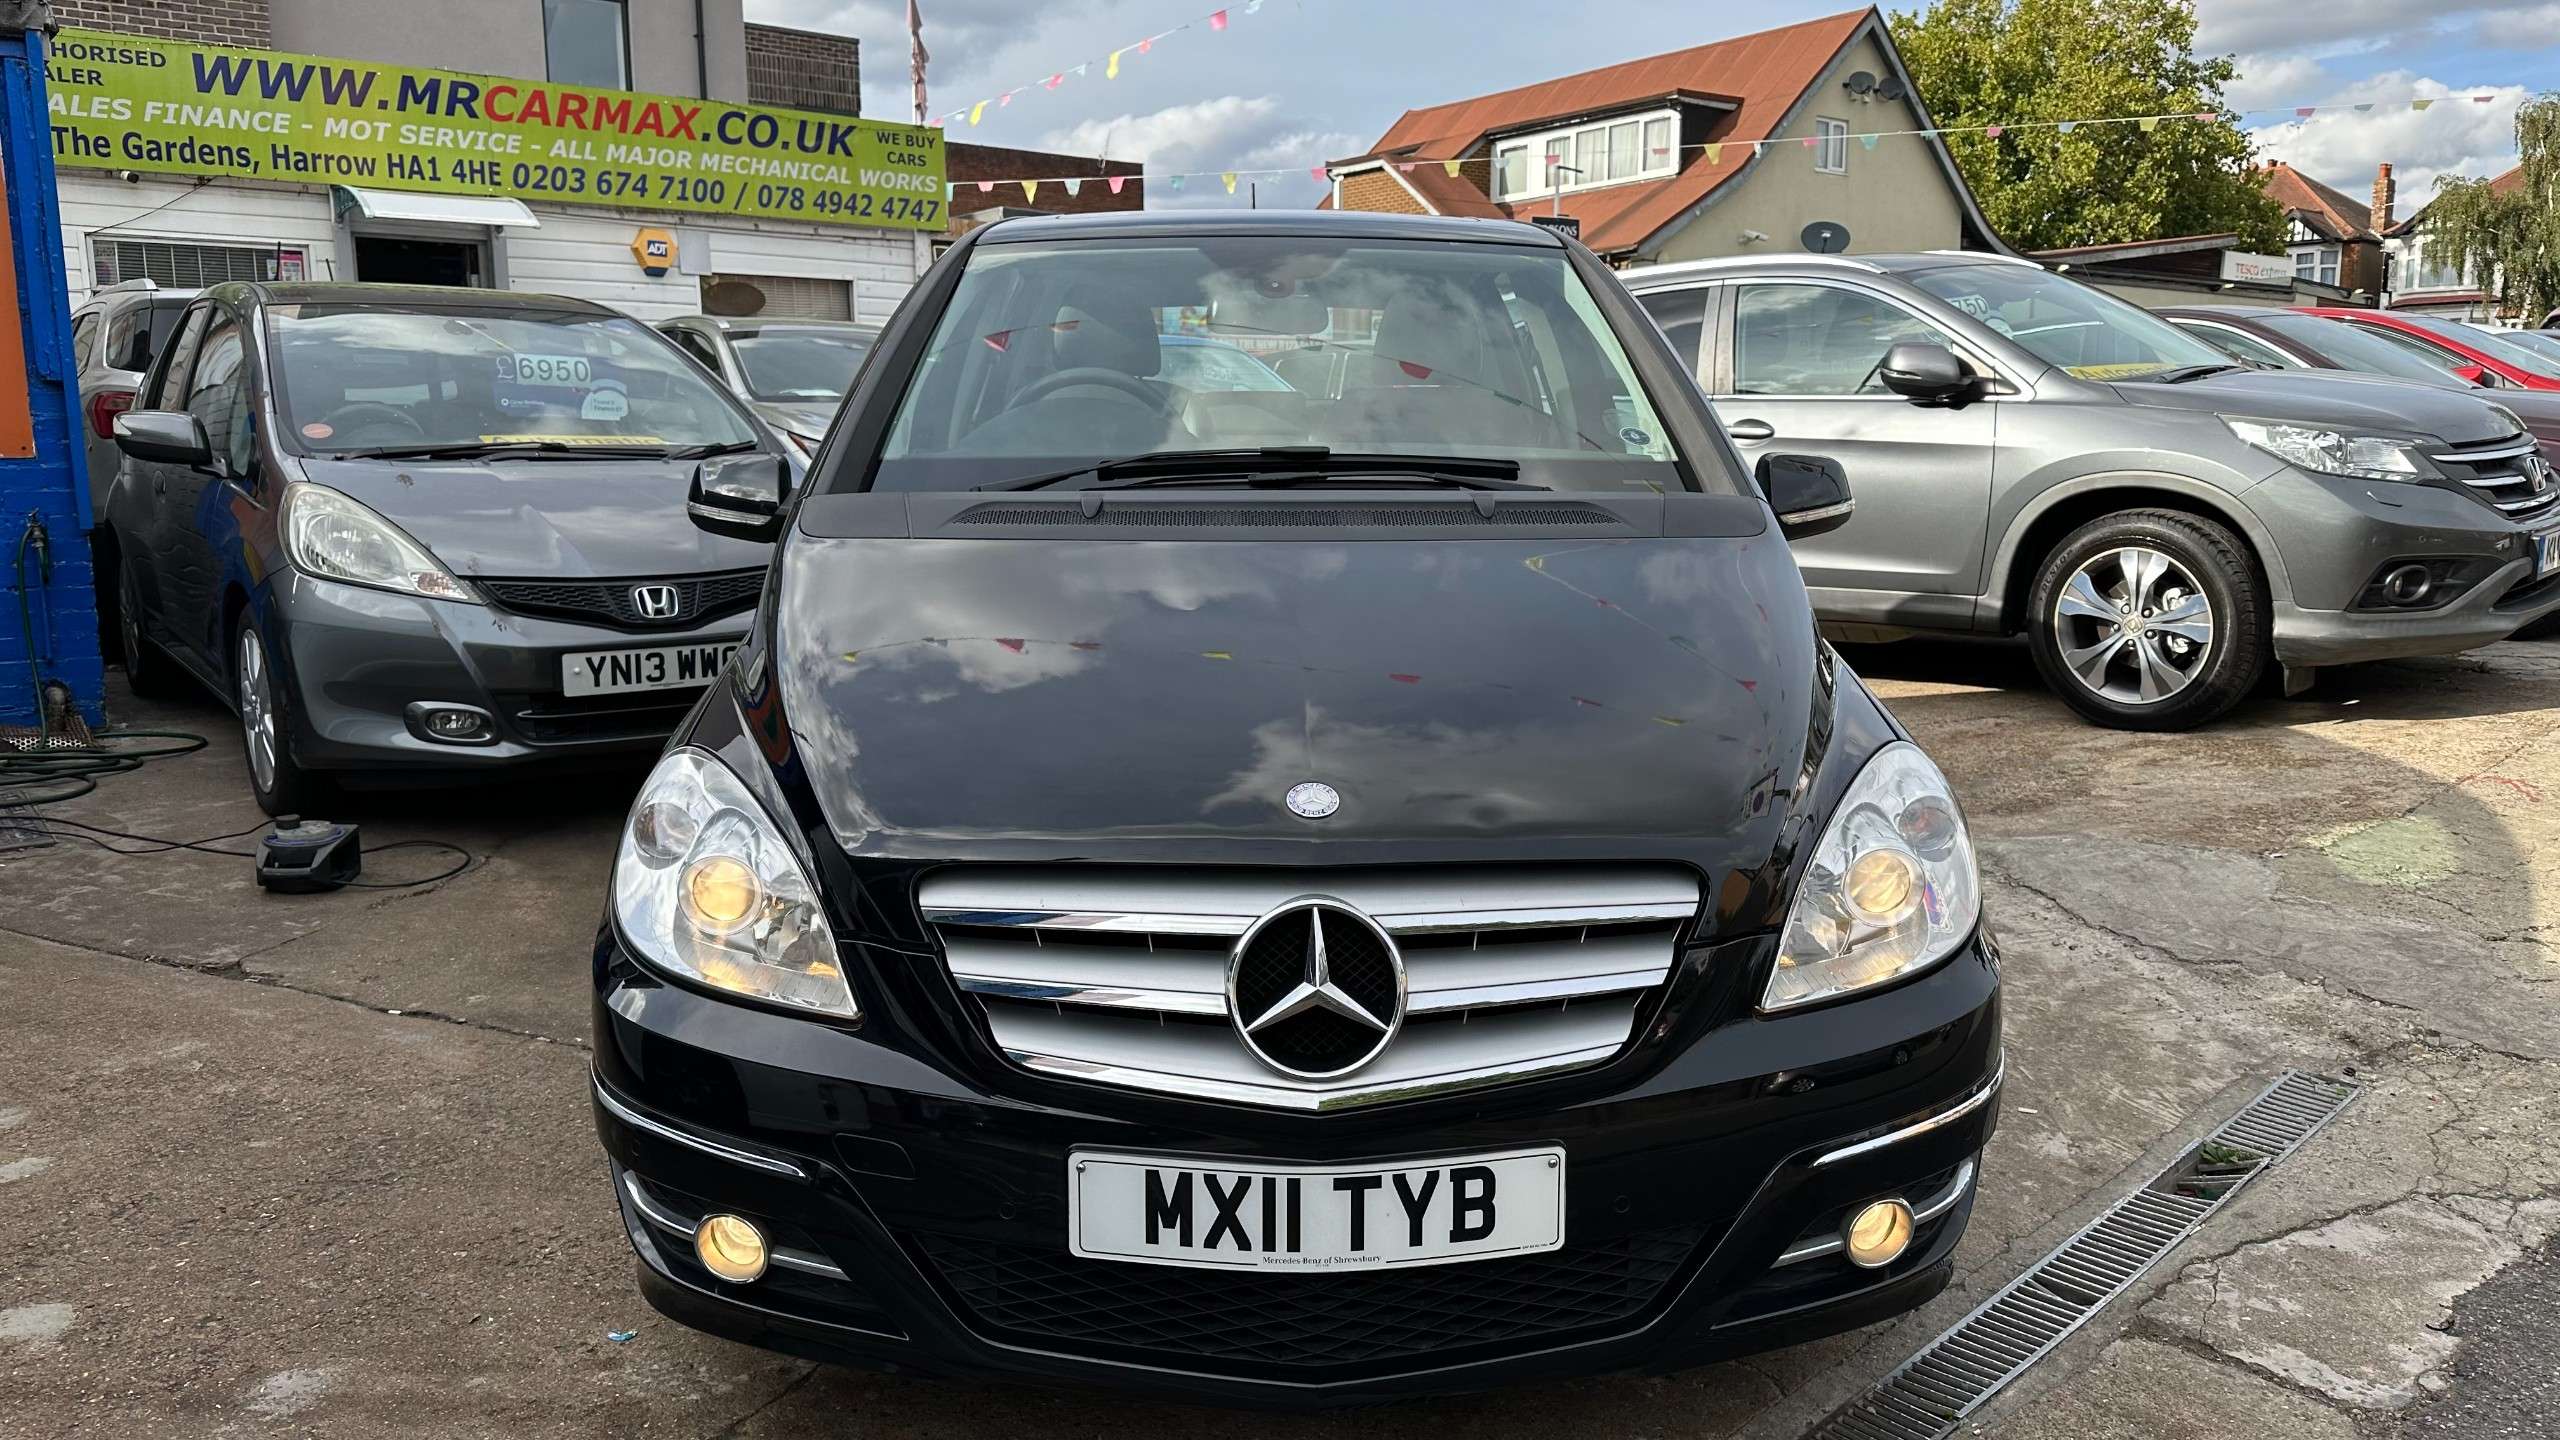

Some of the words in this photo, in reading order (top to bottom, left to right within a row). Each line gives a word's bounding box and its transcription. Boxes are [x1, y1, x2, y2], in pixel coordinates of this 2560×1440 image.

[192, 53, 857, 157] WWW.MRCARMAX.CO.UK
[144, 101, 292, 134] FINANCE
[324, 118, 391, 142] MOT
[399, 124, 523, 154] SERVICE
[549, 139, 597, 161] ALL
[606, 143, 692, 169] MAJOR
[700, 152, 852, 185] MECHANICAL
[860, 169, 938, 193] WORKS
[876, 131, 900, 146] WE
[906, 134, 936, 149] BUY
[887, 151, 927, 167] CARS
[51, 126, 111, 158] The
[122, 131, 260, 174] Gardens,
[271, 143, 376, 177] Harrow
[387, 153, 441, 182] HA1
[451, 158, 501, 186] 4HE
[512, 163, 586, 193] 0203
[597, 170, 648, 198] 674
[659, 175, 725, 204] 7100
[758, 184, 805, 211] 078
[813, 190, 873, 217] 4942
[881, 197, 940, 222] 4747
[648, 243, 667, 255] ADT
[2235, 262, 2259, 276] TESCO
[585, 652, 666, 687] YN13
[1145, 1168, 1301, 1253] MX11
[1333, 1165, 1497, 1251] TYB
[1324, 1256, 1332, 1264] of
[1334, 1255, 1380, 1264] Shrewsbury
